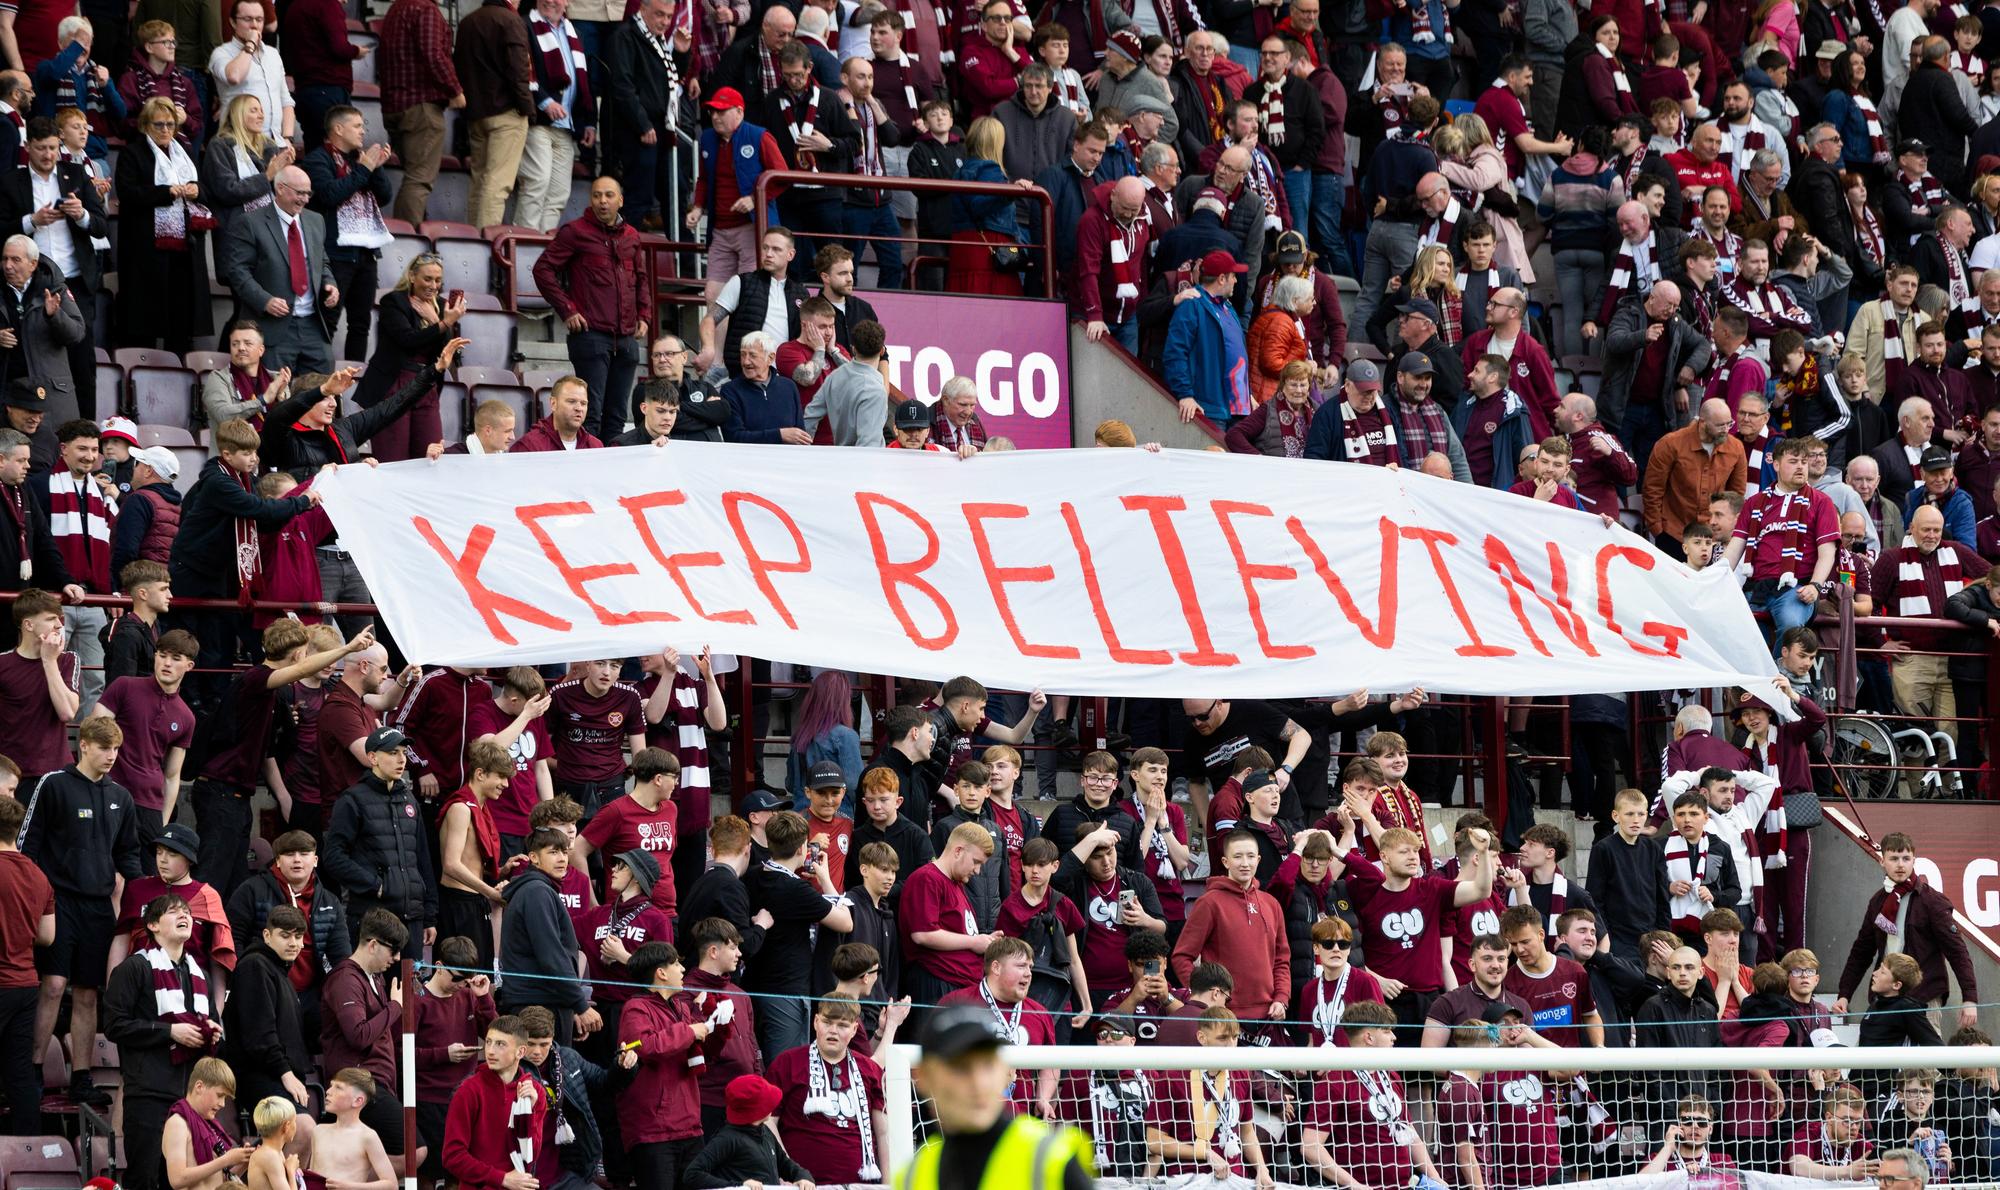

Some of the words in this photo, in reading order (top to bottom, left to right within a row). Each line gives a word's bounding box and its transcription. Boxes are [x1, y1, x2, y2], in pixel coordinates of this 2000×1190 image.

[885, 345, 955, 409] TO
[975, 350, 1059, 418] GO
[1366, 431, 1383, 440] MND
[412, 490, 811, 645] KEEP
[856, 493, 1688, 667] BELIEVING
[516, 763, 528, 771] 22
[640, 838, 673, 852] CITY
